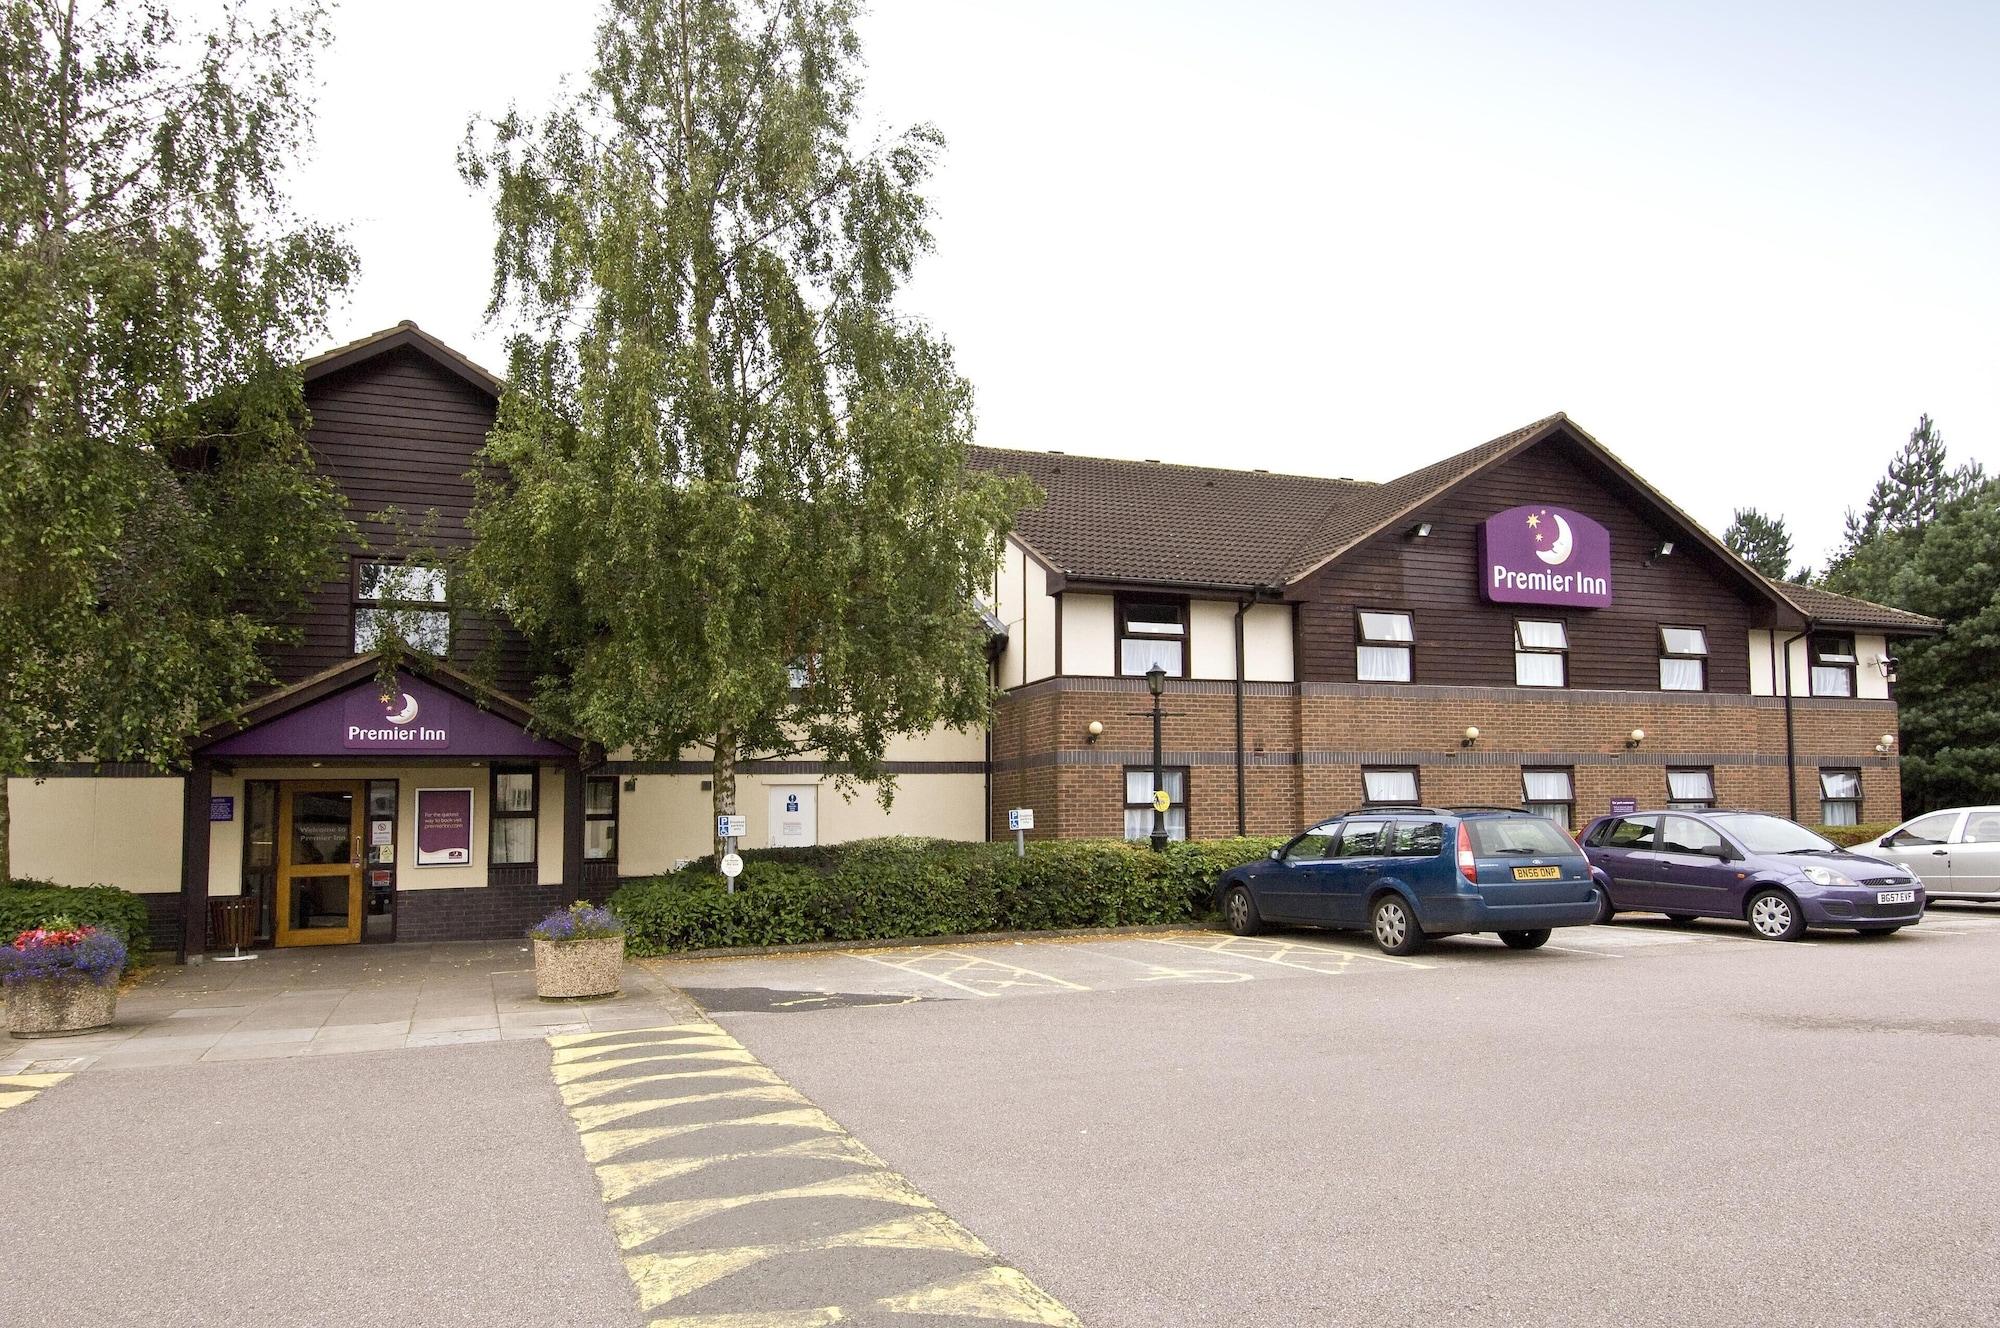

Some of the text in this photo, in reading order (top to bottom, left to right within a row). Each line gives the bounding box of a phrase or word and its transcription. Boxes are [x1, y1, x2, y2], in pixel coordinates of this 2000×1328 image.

[1493, 565, 1607, 595] Premier Inn
[348, 726, 446, 740] Premier Inn
[1517, 868, 1539, 878] BN56
[1880, 893, 1899, 902] BG57
